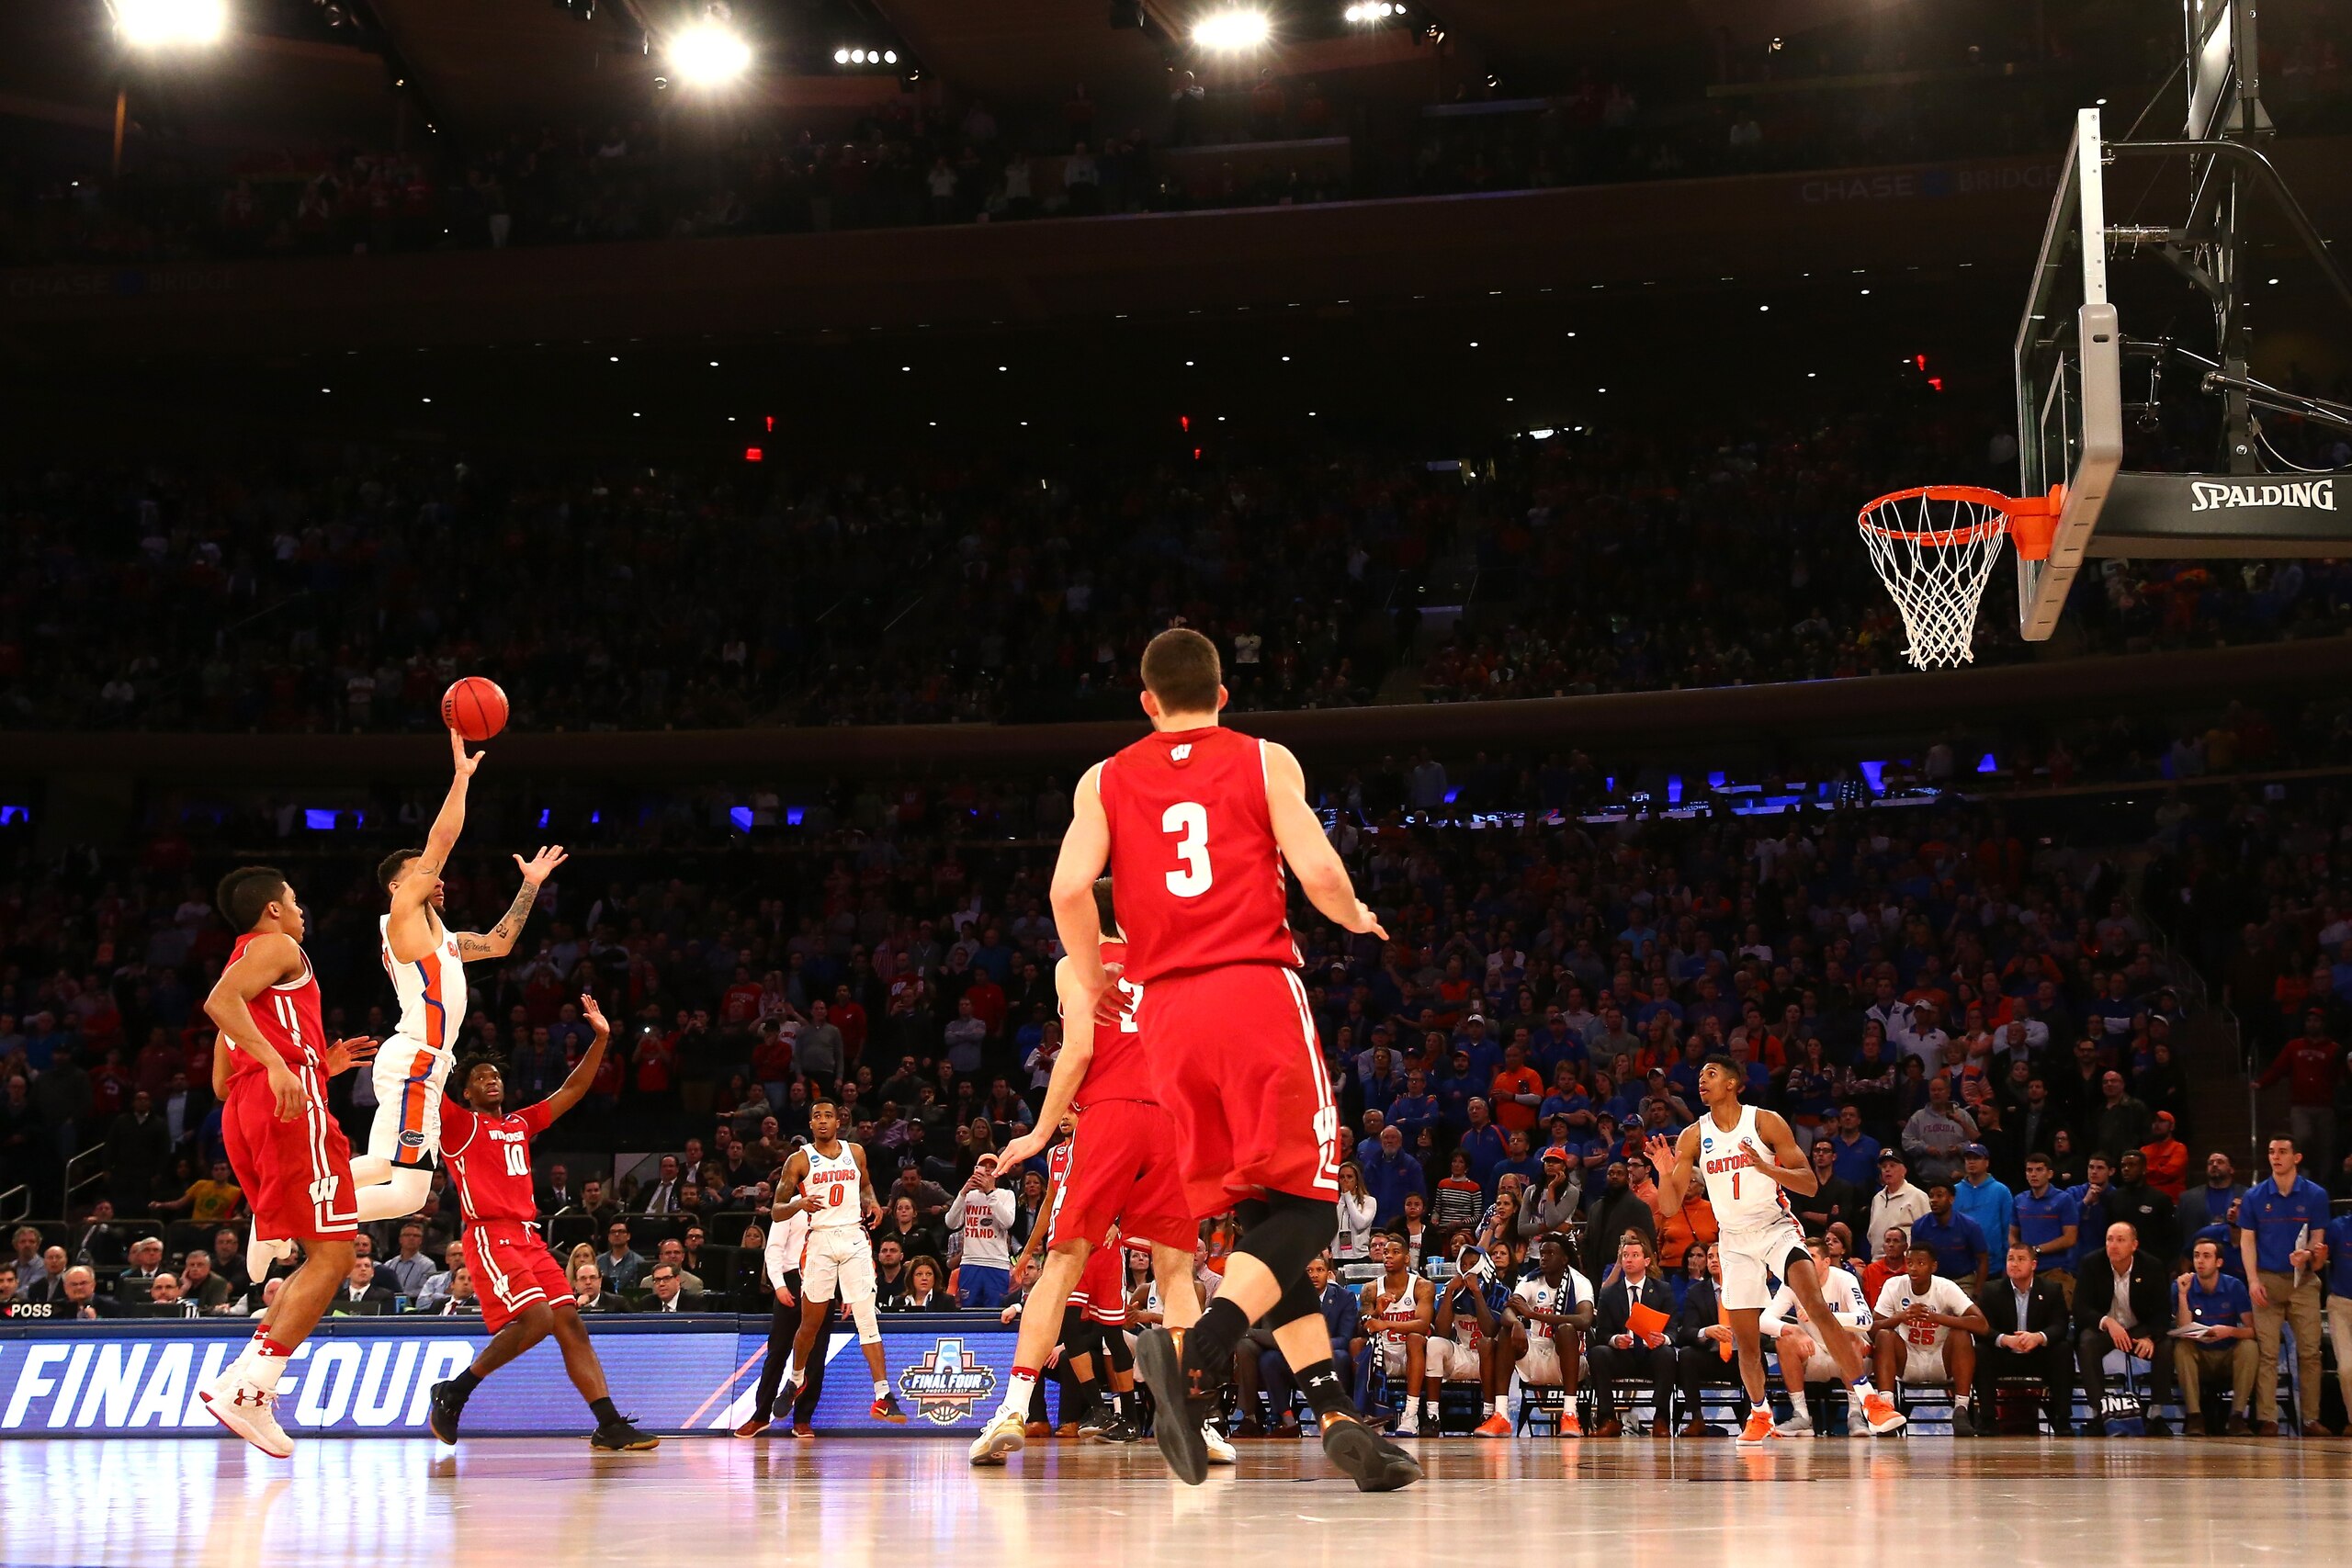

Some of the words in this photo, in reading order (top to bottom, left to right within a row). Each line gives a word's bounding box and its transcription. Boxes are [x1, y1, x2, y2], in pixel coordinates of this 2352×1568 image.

[1802, 175, 1914, 202] CHASE
[1960, 165, 2057, 192] BRIDGE
[10, 275, 110, 297] CHASE
[2191, 479, 2336, 511] SPALDING
[1170, 744, 1192, 761] W
[1162, 802, 1213, 897] 3
[1923, 1122, 1955, 1133] FLORIDA
[503, 1144, 529, 1176] 10
[1706, 1154, 1750, 1175] GATOR
[812, 1168, 855, 1185] GATORS
[1732, 1172, 1740, 1201] 1
[309, 1175, 339, 1205] W
[829, 1183, 844, 1207] 0
[967, 1217, 978, 1227] WE
[11, 1303, 52, 1317] POSS
[1908, 1328, 1935, 1345] 25
[1, 1342, 228, 1428] FINAL
[911, 1374, 946, 1390] FINAL
[948, 1374, 983, 1389] FOUR
